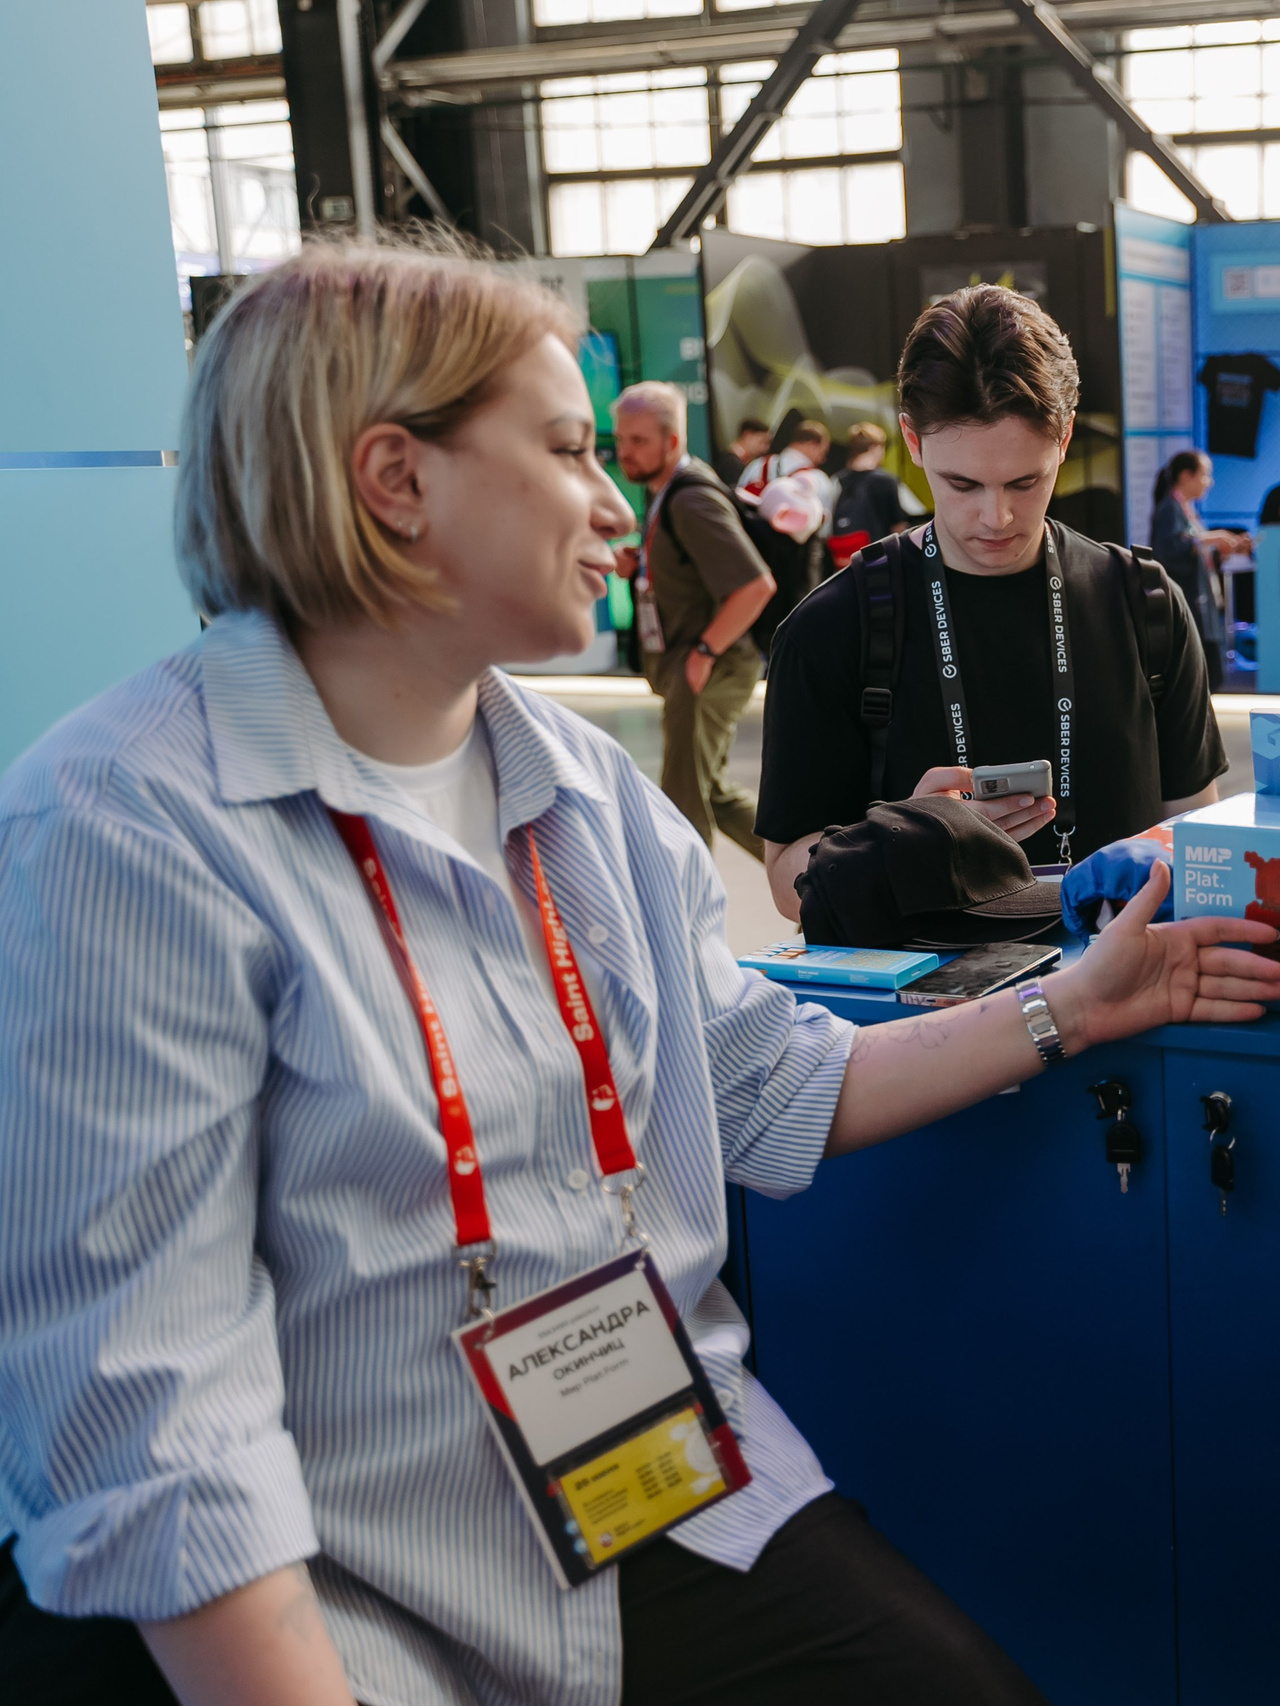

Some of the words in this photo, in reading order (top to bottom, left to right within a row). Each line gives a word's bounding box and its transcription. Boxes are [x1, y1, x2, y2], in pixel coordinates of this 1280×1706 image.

[931, 580, 949, 629] DEVICES
[1053, 592, 1064, 623] SBER
[939, 630, 953, 662] SBER
[1055, 625, 1067, 673] DEVICES
[950, 703, 967, 753] DEVICES
[1060, 714, 1070, 745] SBER
[1060, 748, 1070, 797] DEVICES
[1185, 845, 1232, 864] МИР
[1185, 870, 1225, 889] Plat.
[1185, 887, 1233, 907] Form
[562, 972, 595, 1042] Saint
[508, 1299, 650, 1382] АЛЕКСАНДРА
[553, 1337, 626, 1381] ОКИНЧИЦ
